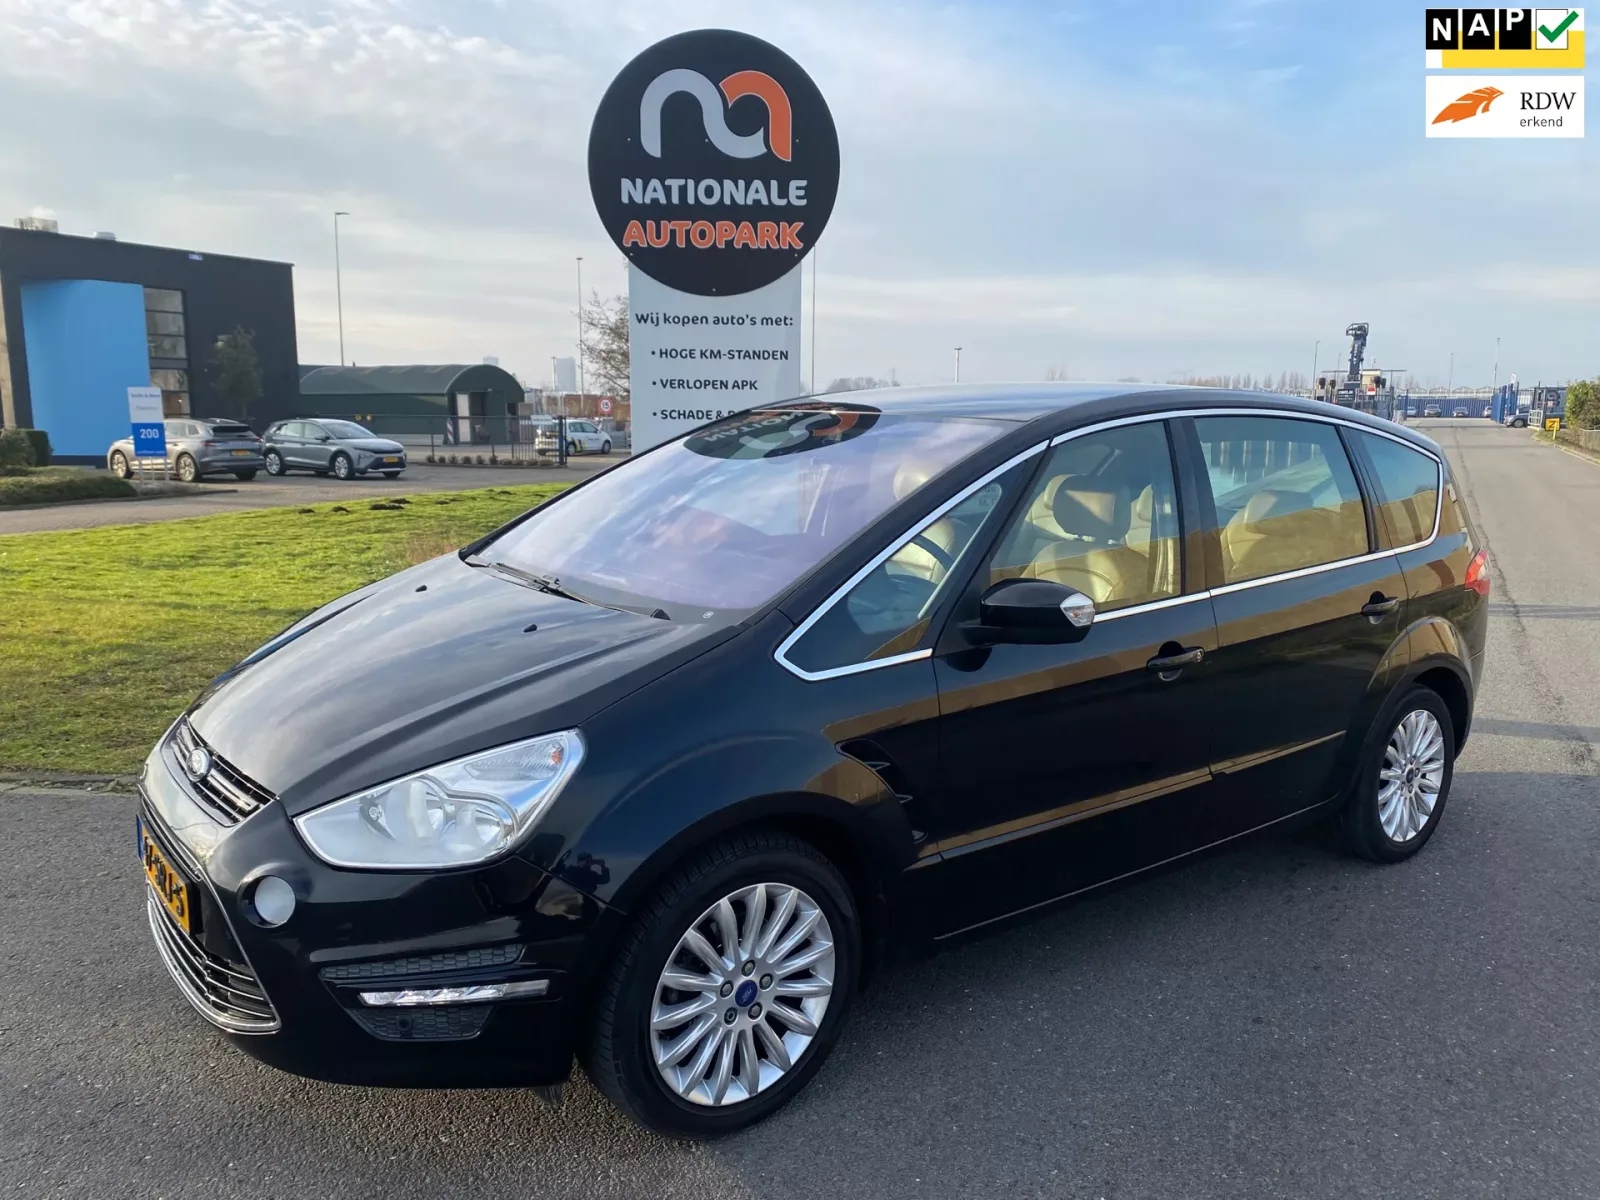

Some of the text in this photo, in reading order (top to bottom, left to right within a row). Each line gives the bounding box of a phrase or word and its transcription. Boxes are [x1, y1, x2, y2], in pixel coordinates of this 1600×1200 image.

[620, 177, 808, 206] NATIONALE
[622, 219, 805, 249] AUTOPARK
[635, 312, 794, 327] Wij kopen auto's met:
[659, 348, 789, 361] HOGE KM-STANDEN
[660, 378, 759, 391] VERLOPEN APK
[660, 409, 713, 421] SCHADE
[140, 428, 159, 439] 200
